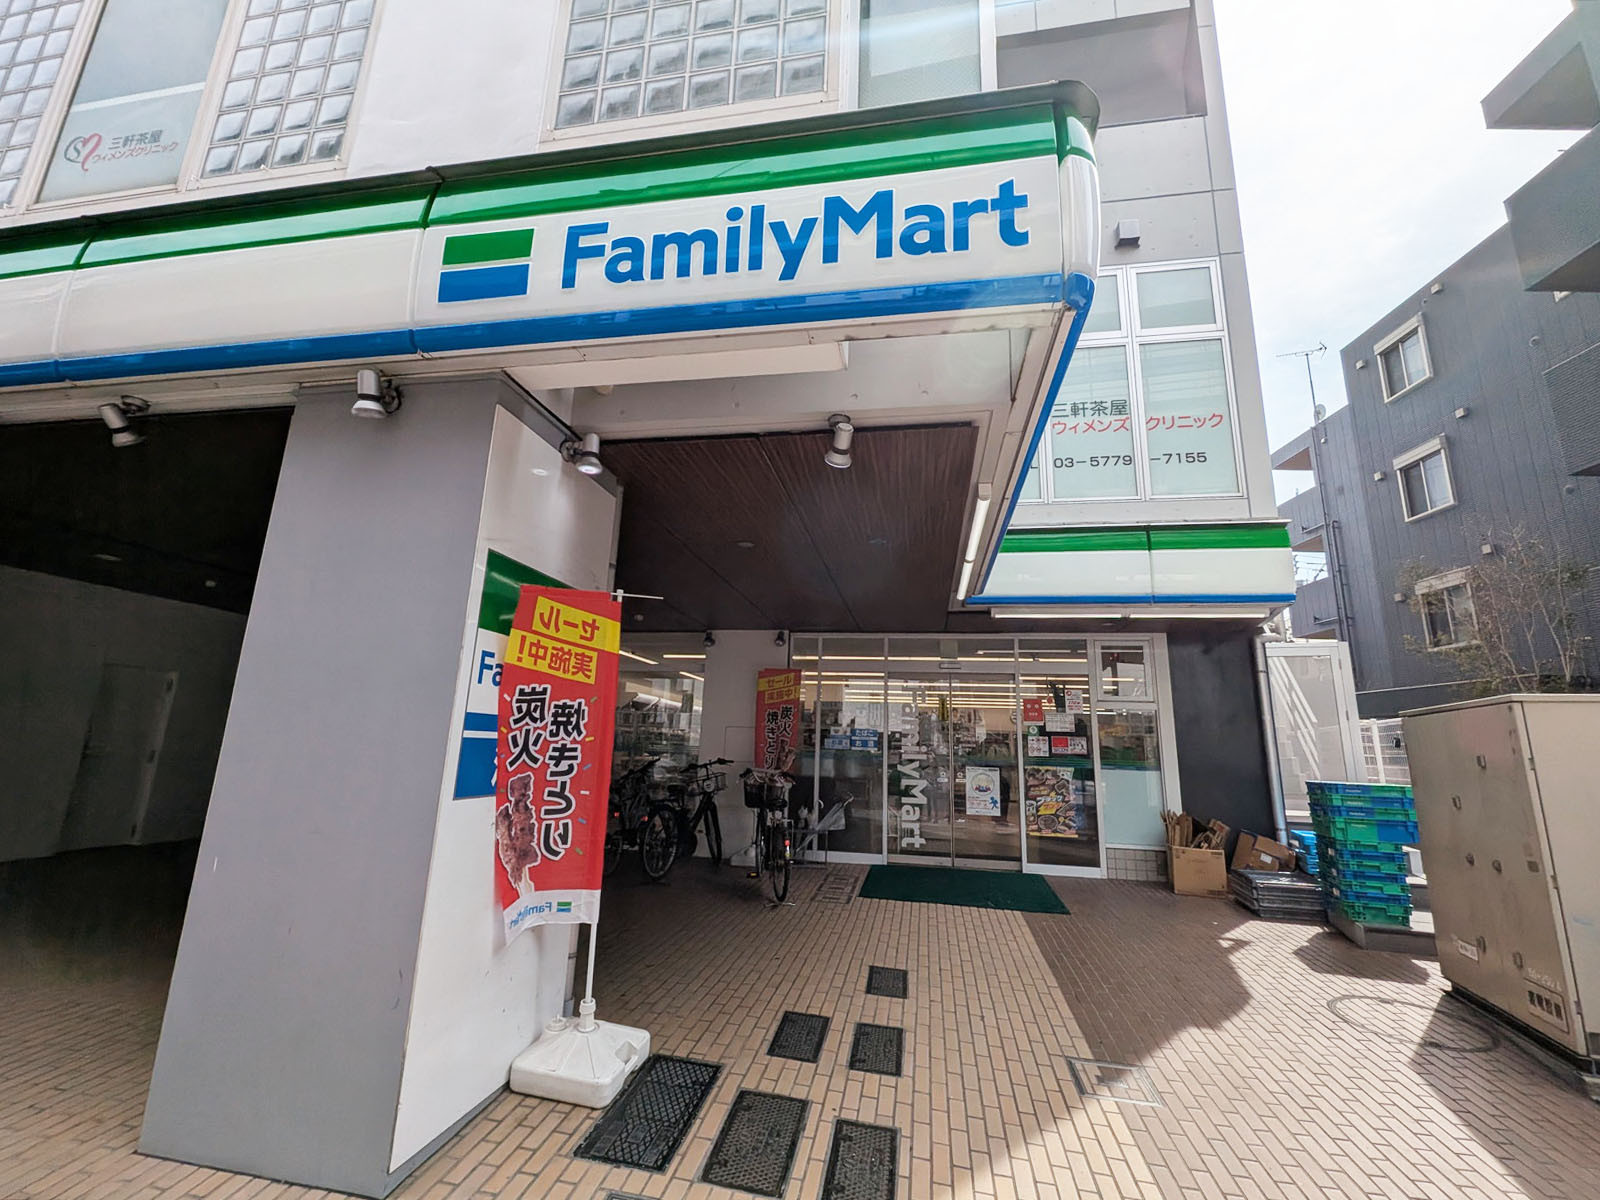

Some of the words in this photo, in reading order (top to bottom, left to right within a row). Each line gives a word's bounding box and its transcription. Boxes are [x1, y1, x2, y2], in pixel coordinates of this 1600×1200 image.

[92, 141, 179, 163] ウィメンズクリニック
[108, 130, 163, 149] 三軒茶屋
[561, 178, 1030, 290] FamilyMart
[1052, 399, 1130, 419] 三軒茶屋
[779, 705, 793, 736] 炭火
[765, 710, 779, 769] 焼きとり
